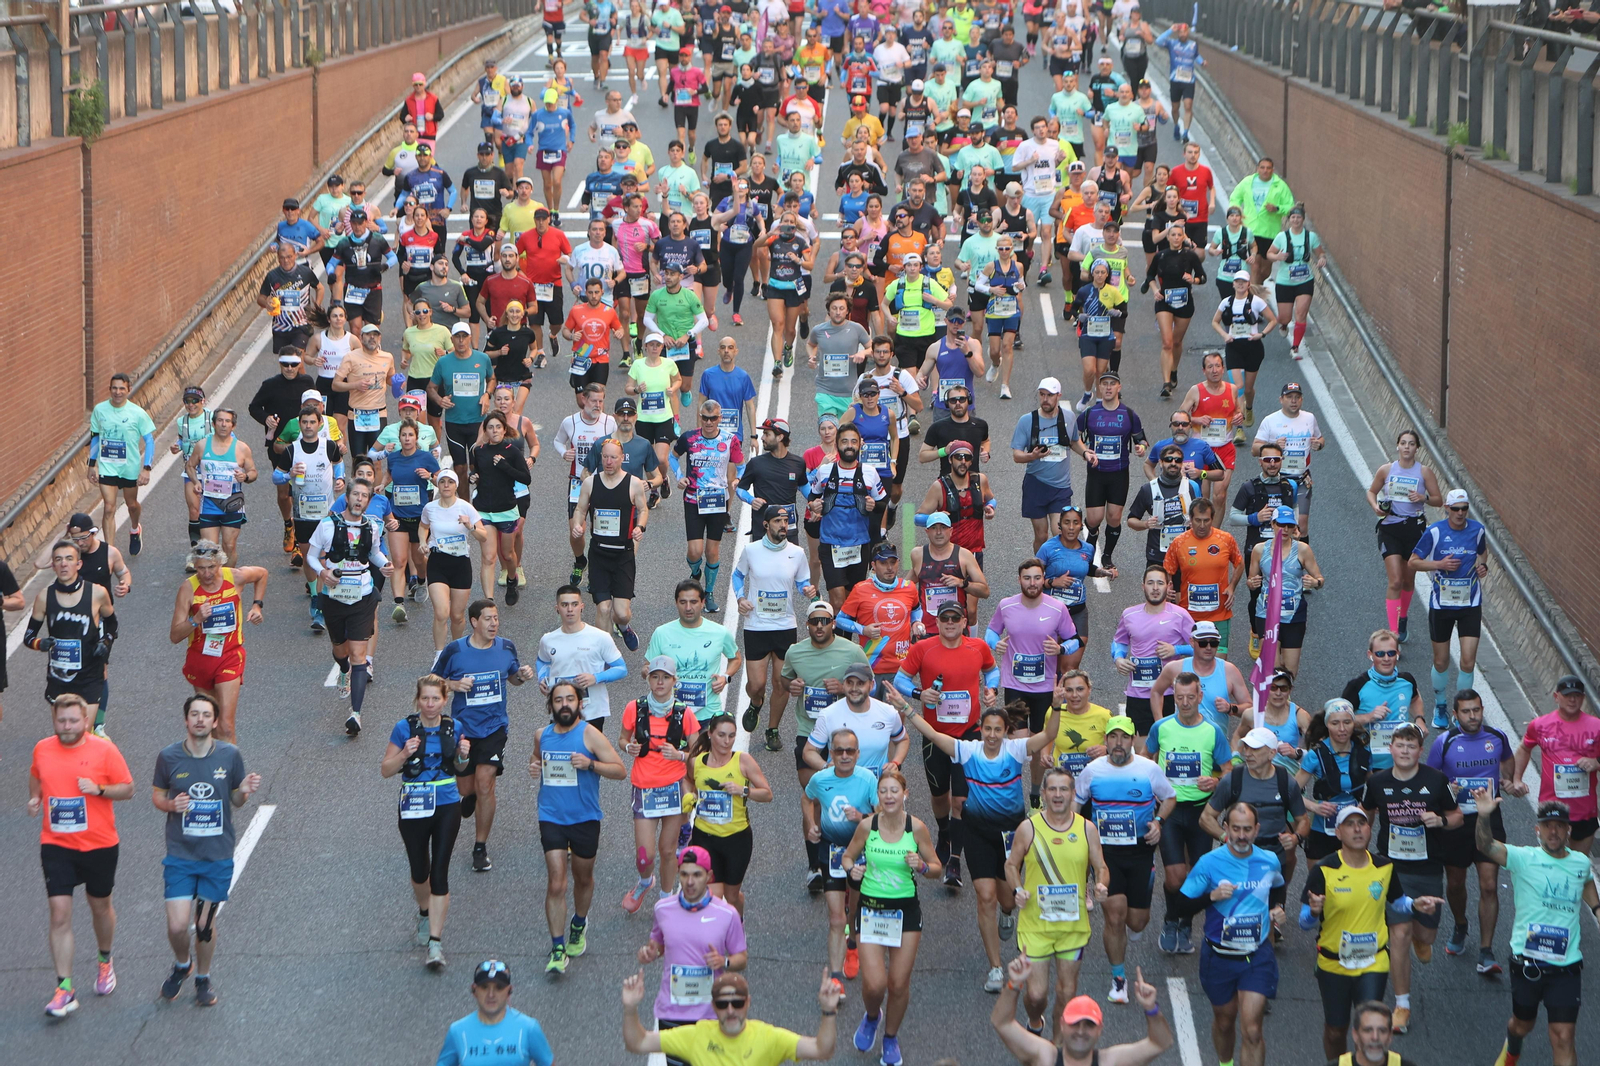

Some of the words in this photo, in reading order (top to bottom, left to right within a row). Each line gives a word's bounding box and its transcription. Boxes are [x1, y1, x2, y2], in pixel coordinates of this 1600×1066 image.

[584, 263, 604, 279] 10
[209, 640, 219, 649] 32
[1457, 758, 1498, 768] FILIPIDES
[654, 785, 675, 793] ZURICH
[874, 921, 889, 929] 11017
[1543, 928, 1564, 936] ZURICH
